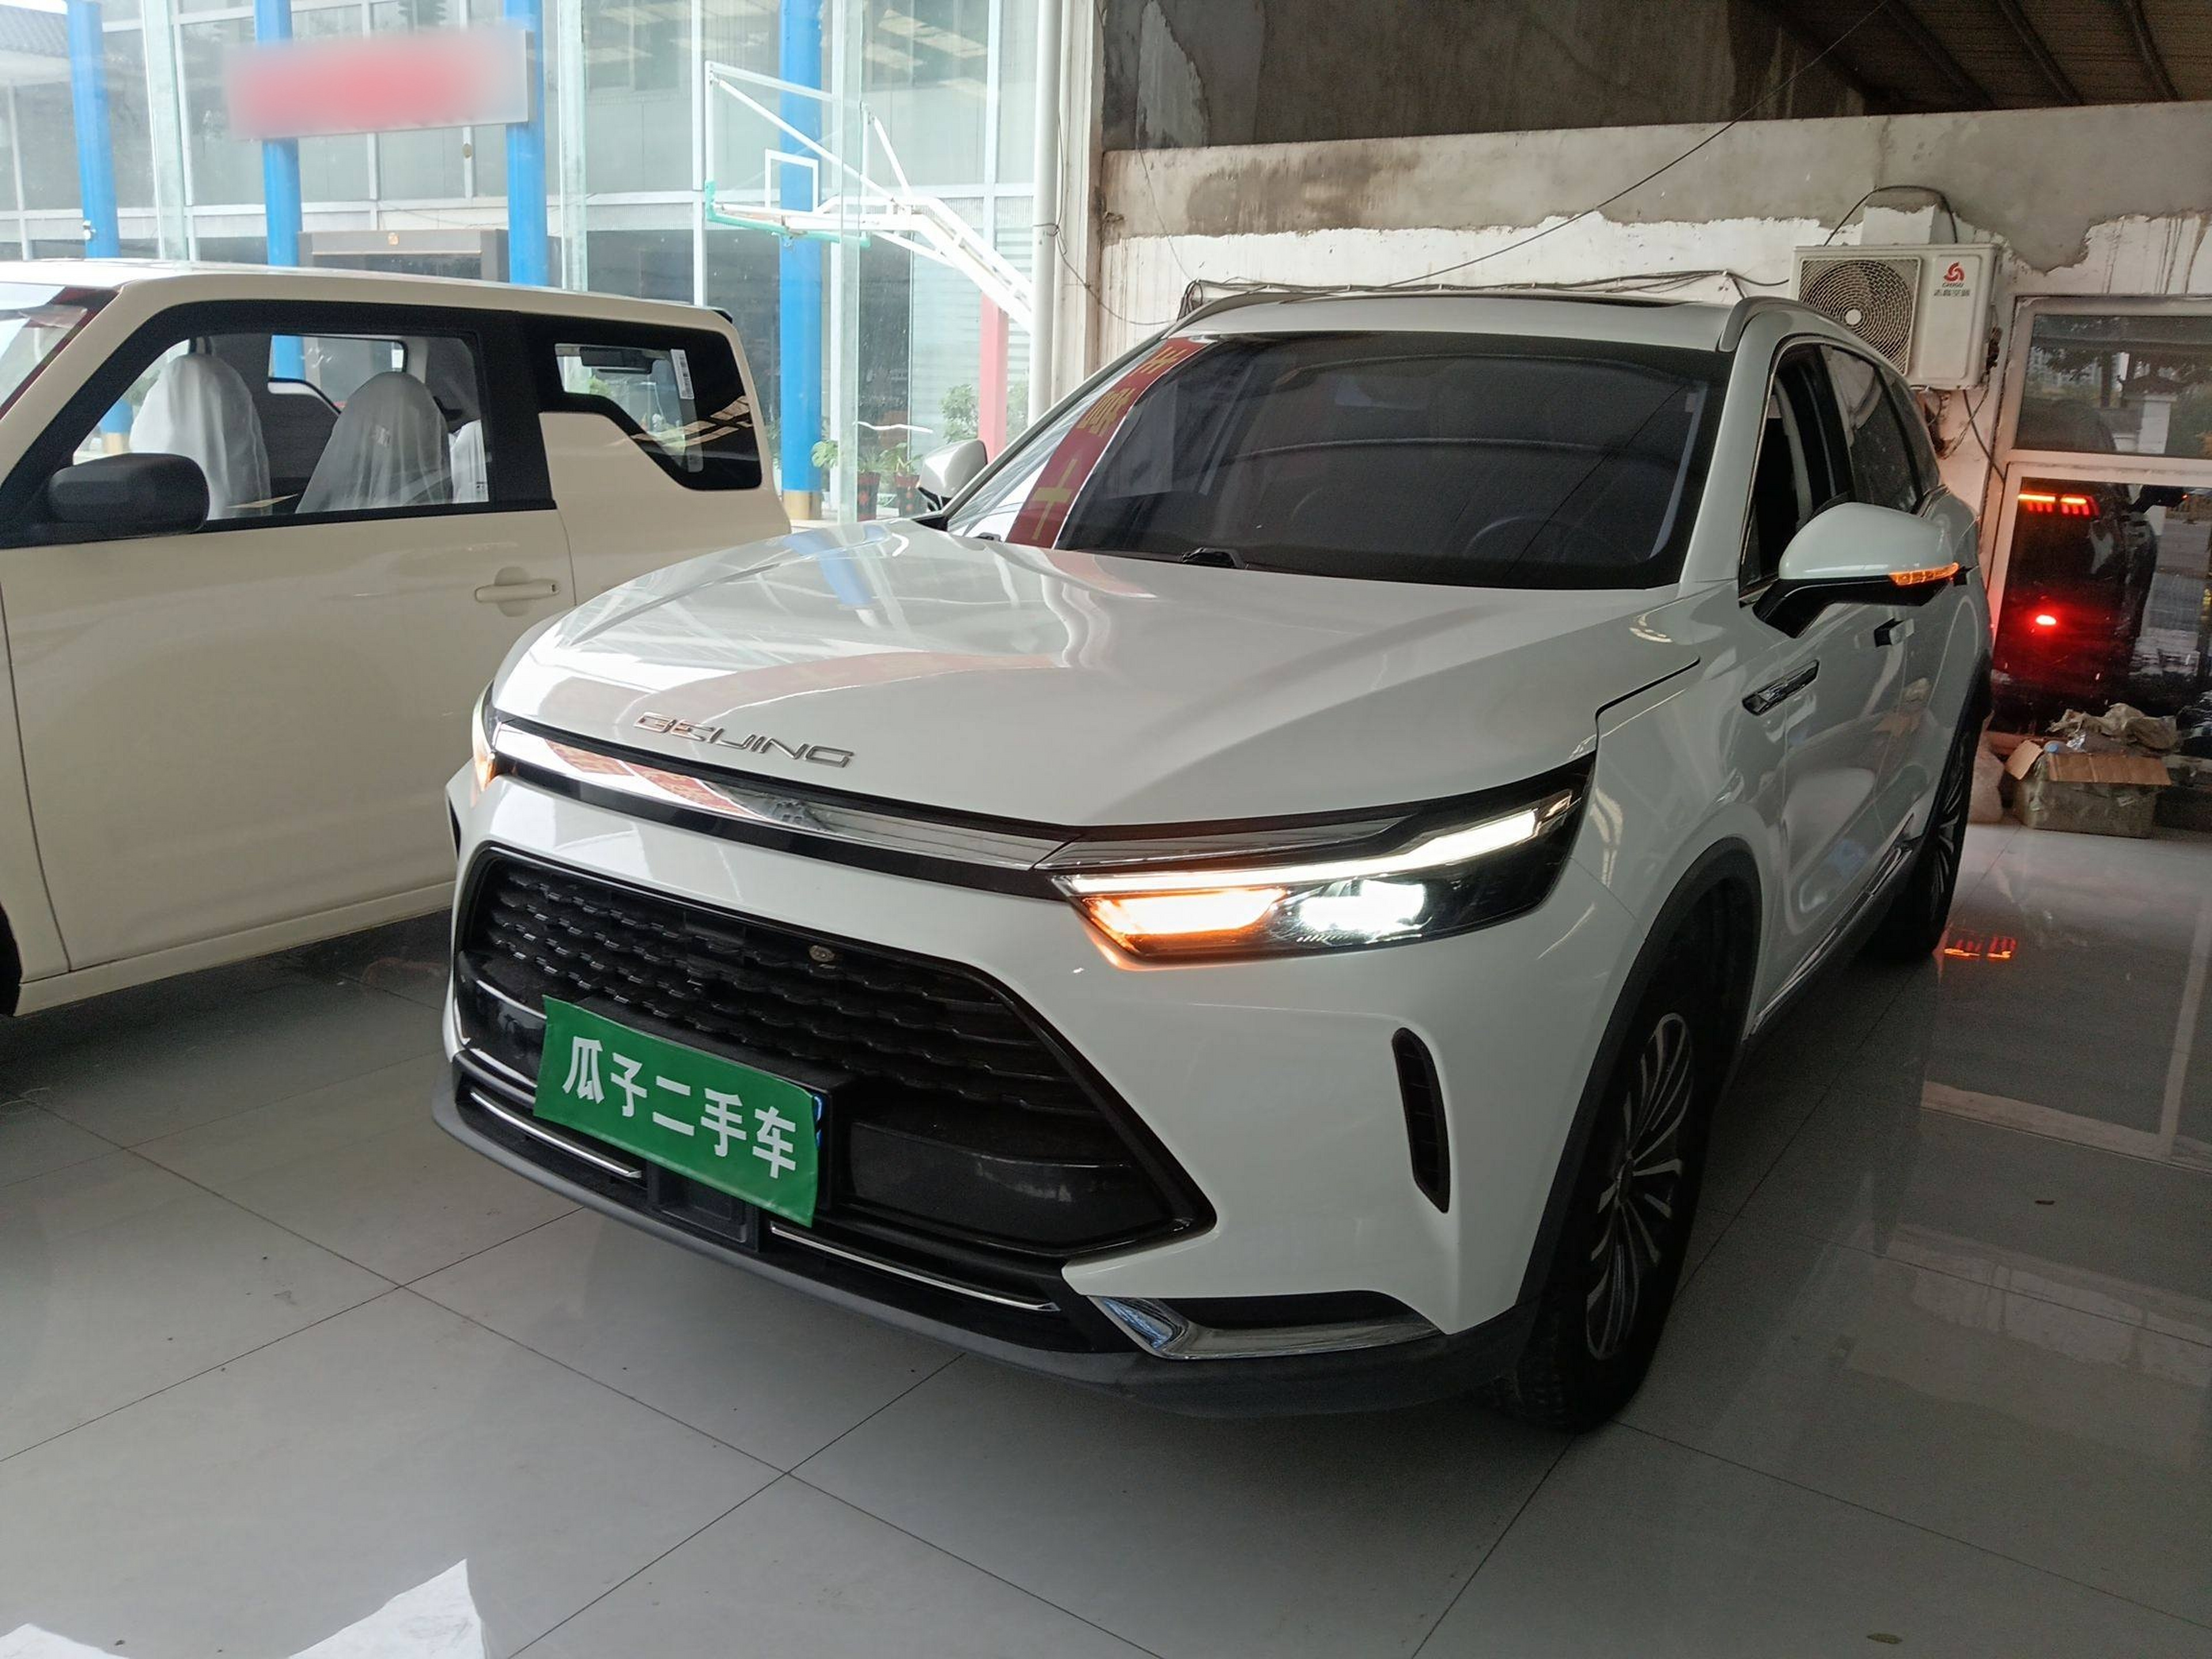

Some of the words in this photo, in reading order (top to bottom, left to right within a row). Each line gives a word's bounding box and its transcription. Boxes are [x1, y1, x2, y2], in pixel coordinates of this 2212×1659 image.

[634, 712, 854, 768] BEIJING
[562, 1036, 797, 1179] 瓜子二手车
